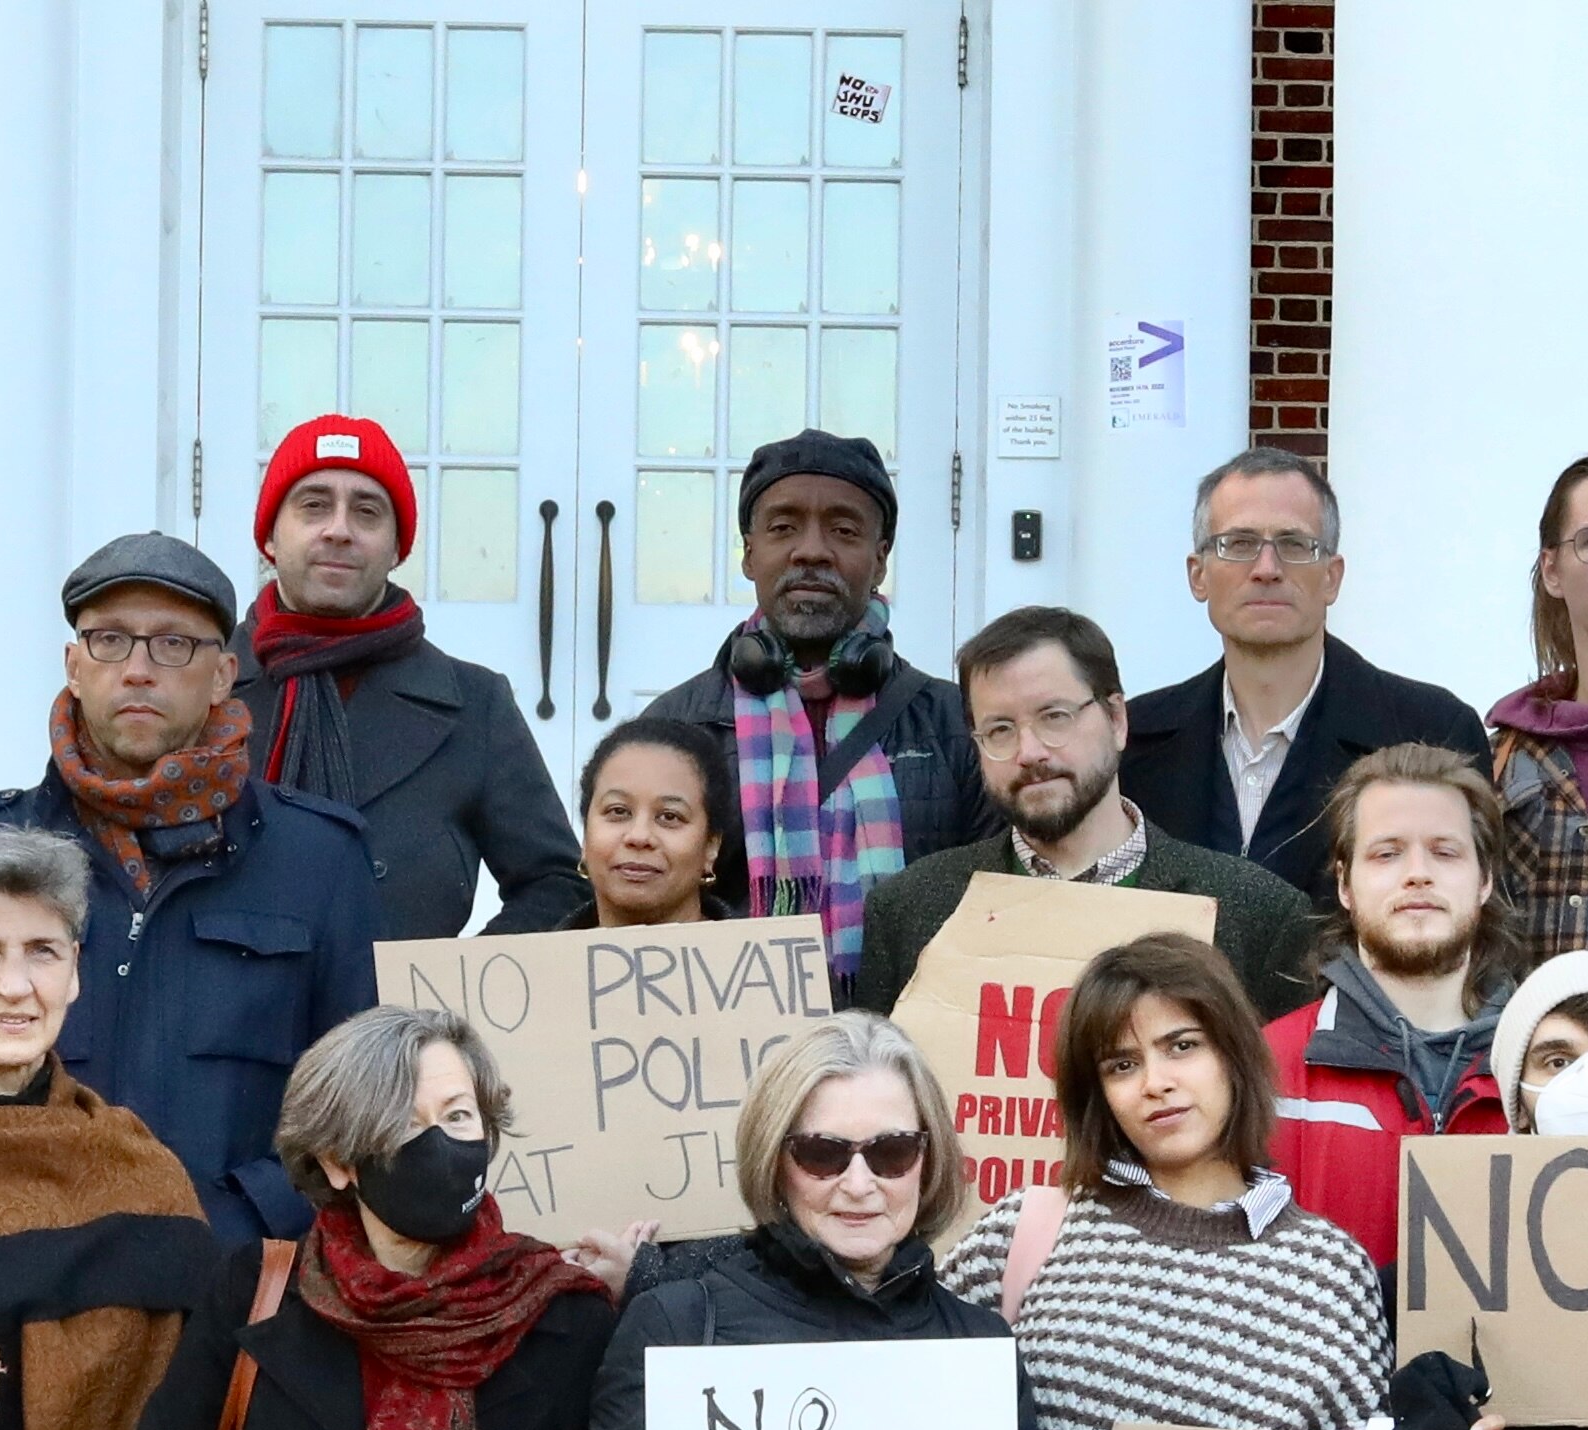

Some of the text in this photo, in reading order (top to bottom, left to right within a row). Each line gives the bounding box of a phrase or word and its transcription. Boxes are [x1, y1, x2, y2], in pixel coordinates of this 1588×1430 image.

[840, 74, 865, 90] NO
[837, 90, 874, 107] JHU
[840, 105, 879, 123] COPS
[1020, 403, 1050, 411] Smoking
[410, 938, 830, 1033] NO PRIVATE
[494, 1144, 574, 1216] AT
